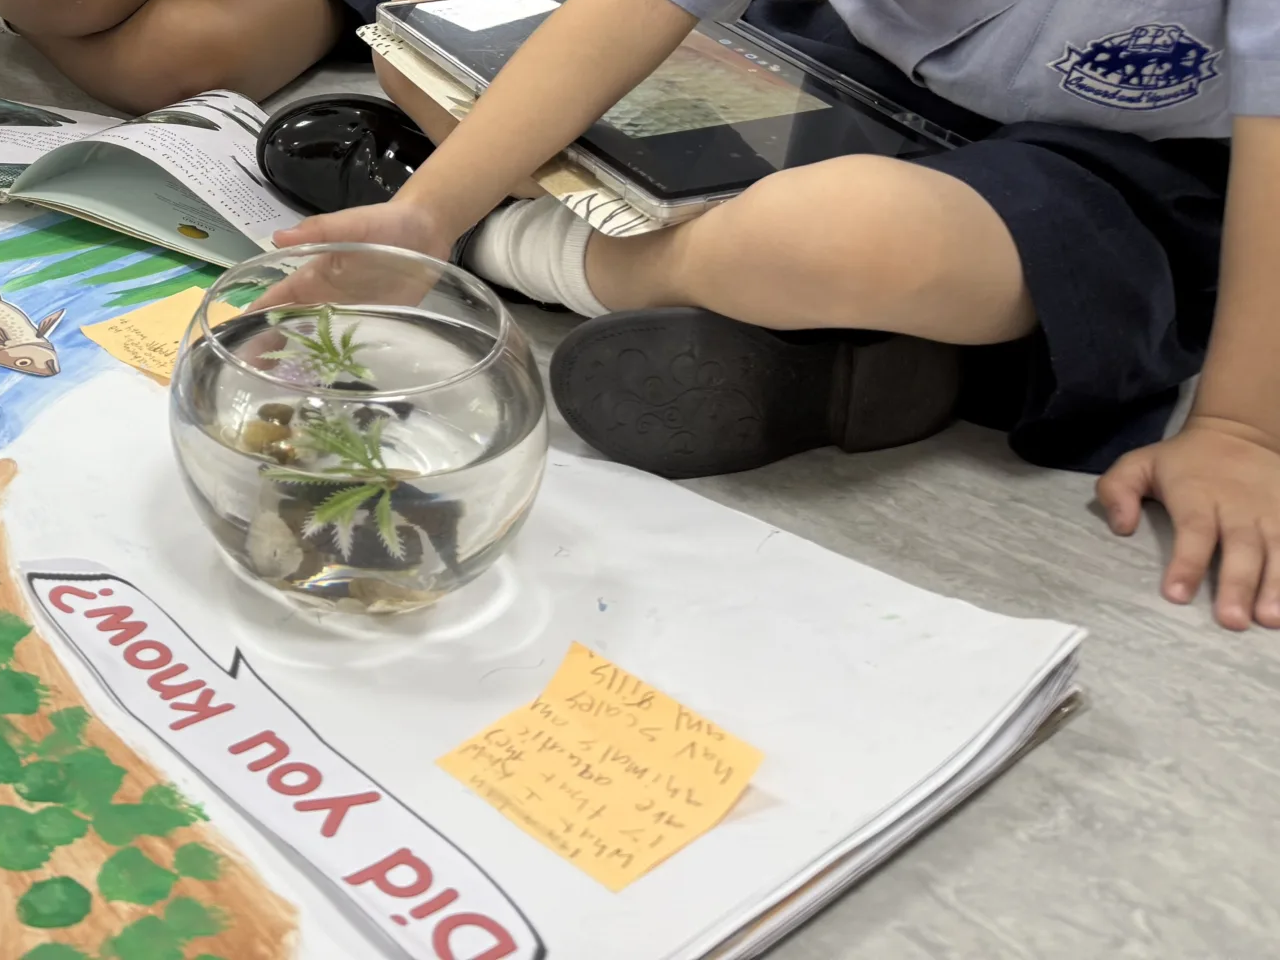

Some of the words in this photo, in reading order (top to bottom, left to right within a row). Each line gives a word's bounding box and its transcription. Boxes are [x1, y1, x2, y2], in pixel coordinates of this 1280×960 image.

[135, 139, 158, 152] sea
[161, 152, 204, 186] silvery
[219, 200, 241, 218] am
[46, 584, 237, 732] know?
[227, 729, 382, 839] you
[340, 845, 519, 960] Did
